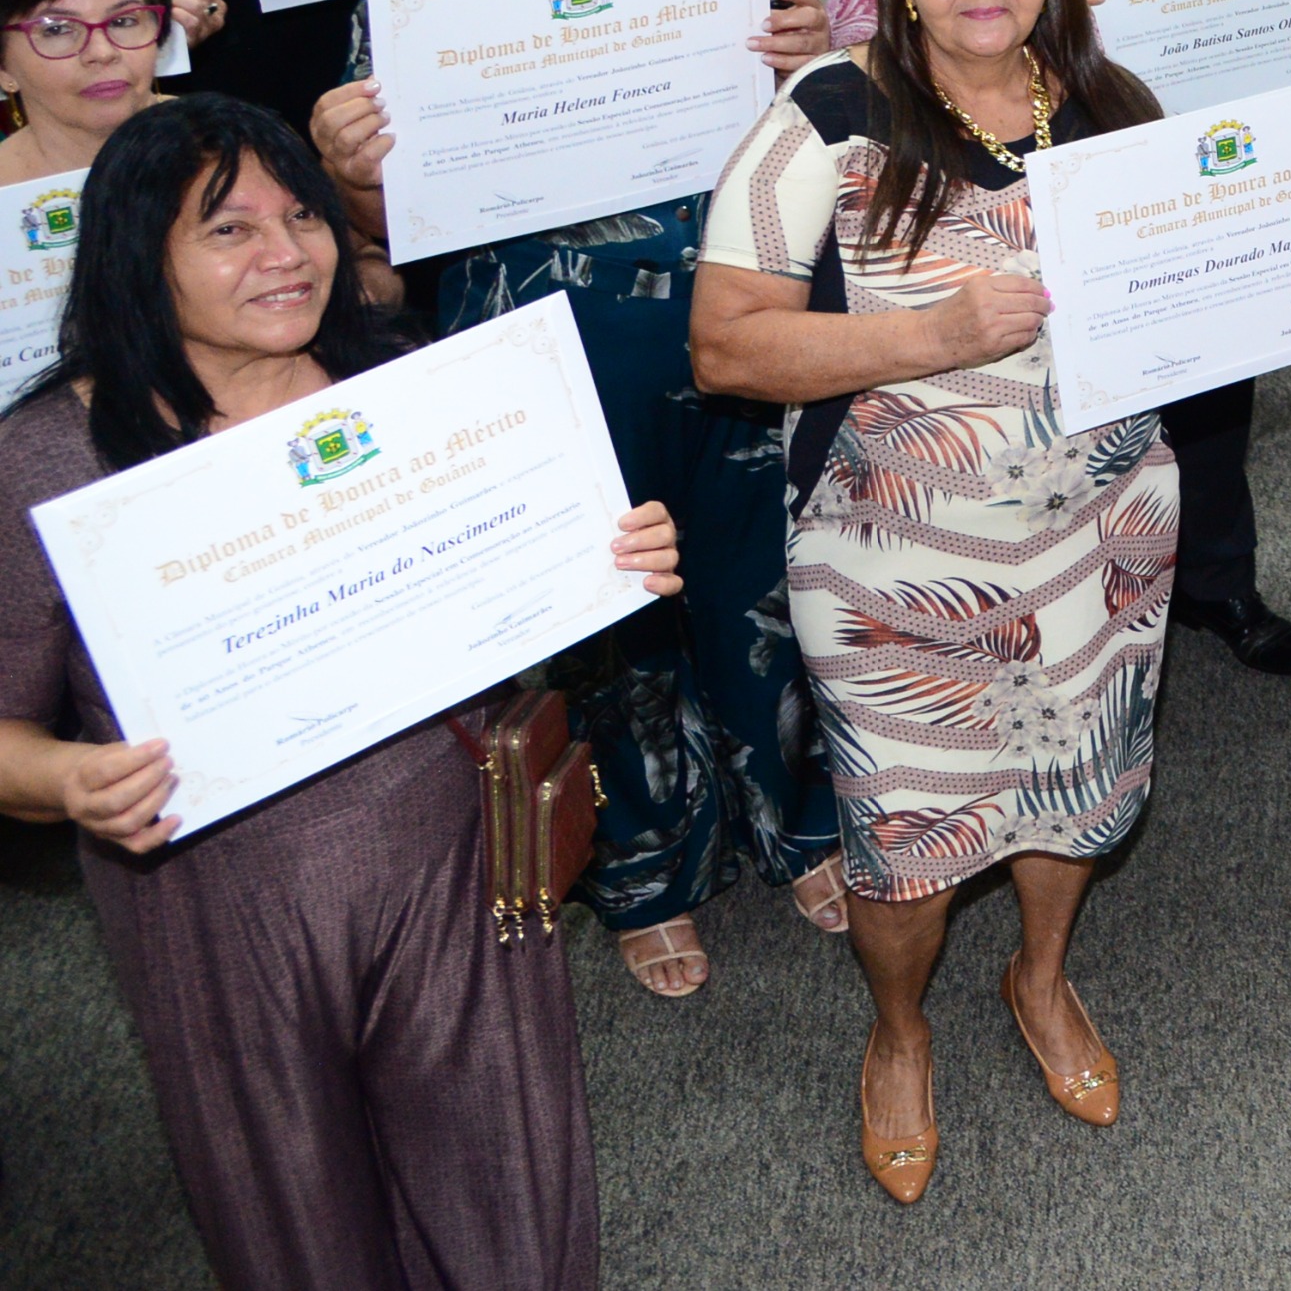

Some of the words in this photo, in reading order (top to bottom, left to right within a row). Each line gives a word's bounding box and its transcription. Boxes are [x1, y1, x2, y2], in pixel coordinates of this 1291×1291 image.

[435, 40, 525, 68] Diploma
[531, 33, 552, 49] de
[559, 20, 622, 46] Honra
[628, 14, 649, 30] ao
[655, 0, 718, 26] Mérito
[480, 60, 536, 79] Câmara
[540, 42, 609, 68] Municipal
[612, 41, 627, 52] de
[630, 29, 682, 48] Goiânia
[1159, 42, 1188, 57] João
[1192, 33, 1232, 49] Batista
[1235, 24, 1274, 39] Santos
[501, 106, 547, 125] Maria
[553, 95, 606, 114] Helena
[612, 81, 670, 102] Fonseca
[1095, 198, 1177, 230] Diploma
[1181, 191, 1202, 207] de
[1207, 175, 1266, 203] Honra
[1272, 169, 1291, 184] ao
[1136, 218, 1187, 239] Câmara
[1191, 198, 1255, 226] Municipal
[1258, 196, 1271, 207] de
[1128, 266, 1199, 293] Domingas
[1204, 247, 1264, 273] Dourado
[154, 523, 276, 587] Diploma
[279, 507, 309, 530] de
[316, 466, 402, 517] Honra
[409, 450, 436, 473] ao
[444, 409, 526, 460] Mérito
[222, 544, 297, 583] Câmara
[302, 497, 392, 551] Municipal
[393, 489, 414, 505] de
[418, 456, 486, 494] Goiânia
[221, 601, 319, 653] Terezinha
[327, 570, 384, 605] Maria
[391, 557, 413, 575] do
[420, 503, 525, 561] Nascimento
